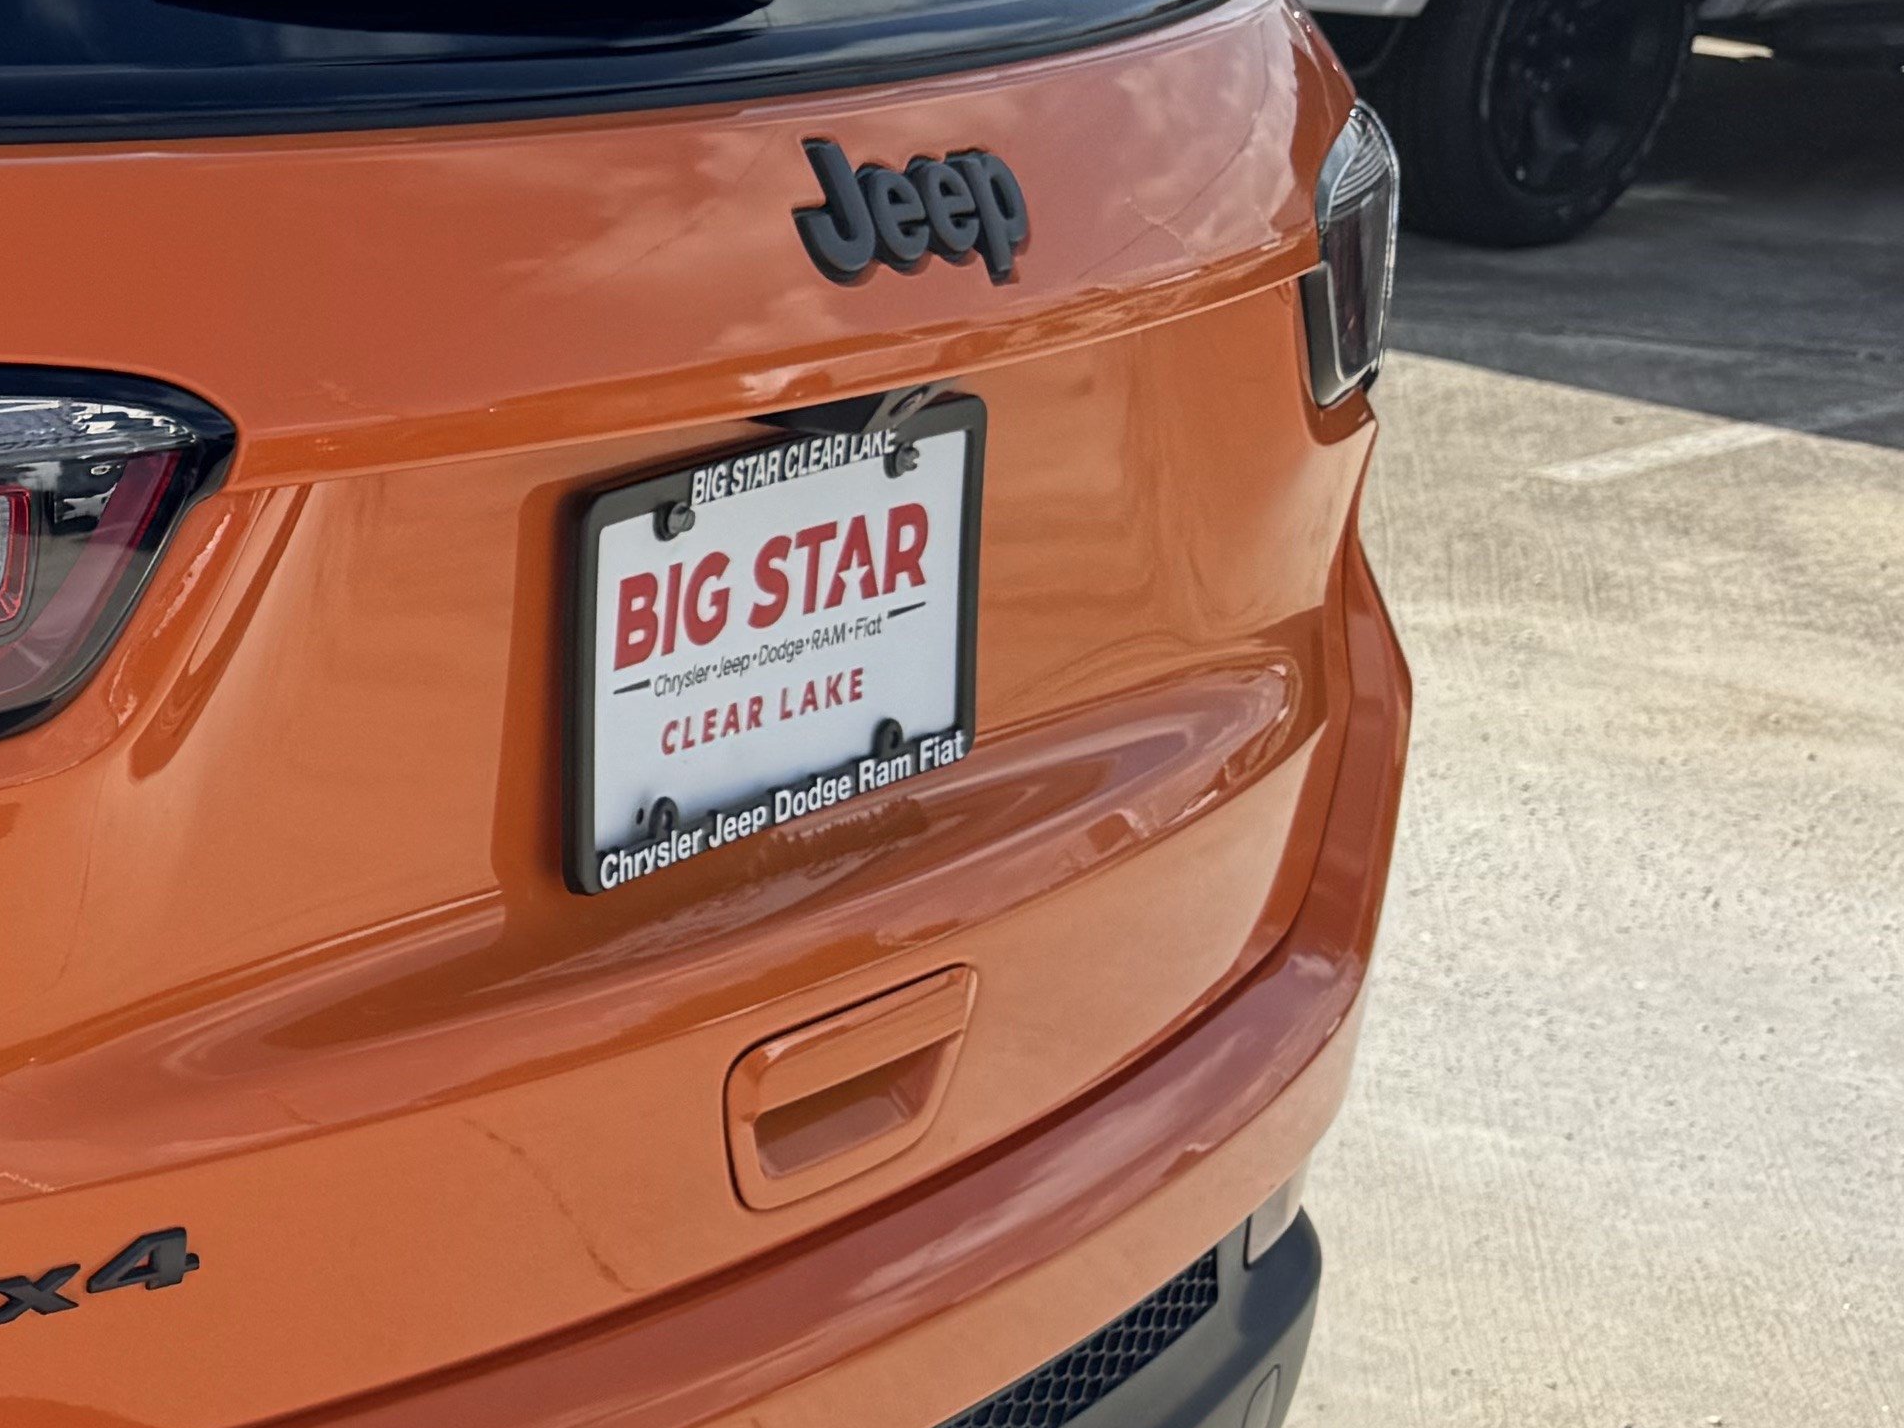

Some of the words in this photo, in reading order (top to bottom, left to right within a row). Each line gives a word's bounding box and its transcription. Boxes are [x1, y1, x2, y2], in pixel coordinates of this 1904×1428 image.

[792, 138, 1028, 286] Jeep
[692, 468, 727, 505] BIG
[731, 451, 782, 494] STAR
[784, 434, 846, 479] CLEAR
[849, 429, 897, 462] LAKE
[613, 551, 732, 672] BIG
[748, 503, 929, 629] STAR
[661, 696, 764, 755] CLEAR
[779, 667, 864, 721] LAKE
[599, 825, 703, 892] Chrysler
[708, 804, 767, 849] Jeep
[774, 778, 852, 824] Dodge
[858, 753, 912, 790] Ram
[919, 729, 964, 774] Fiat
